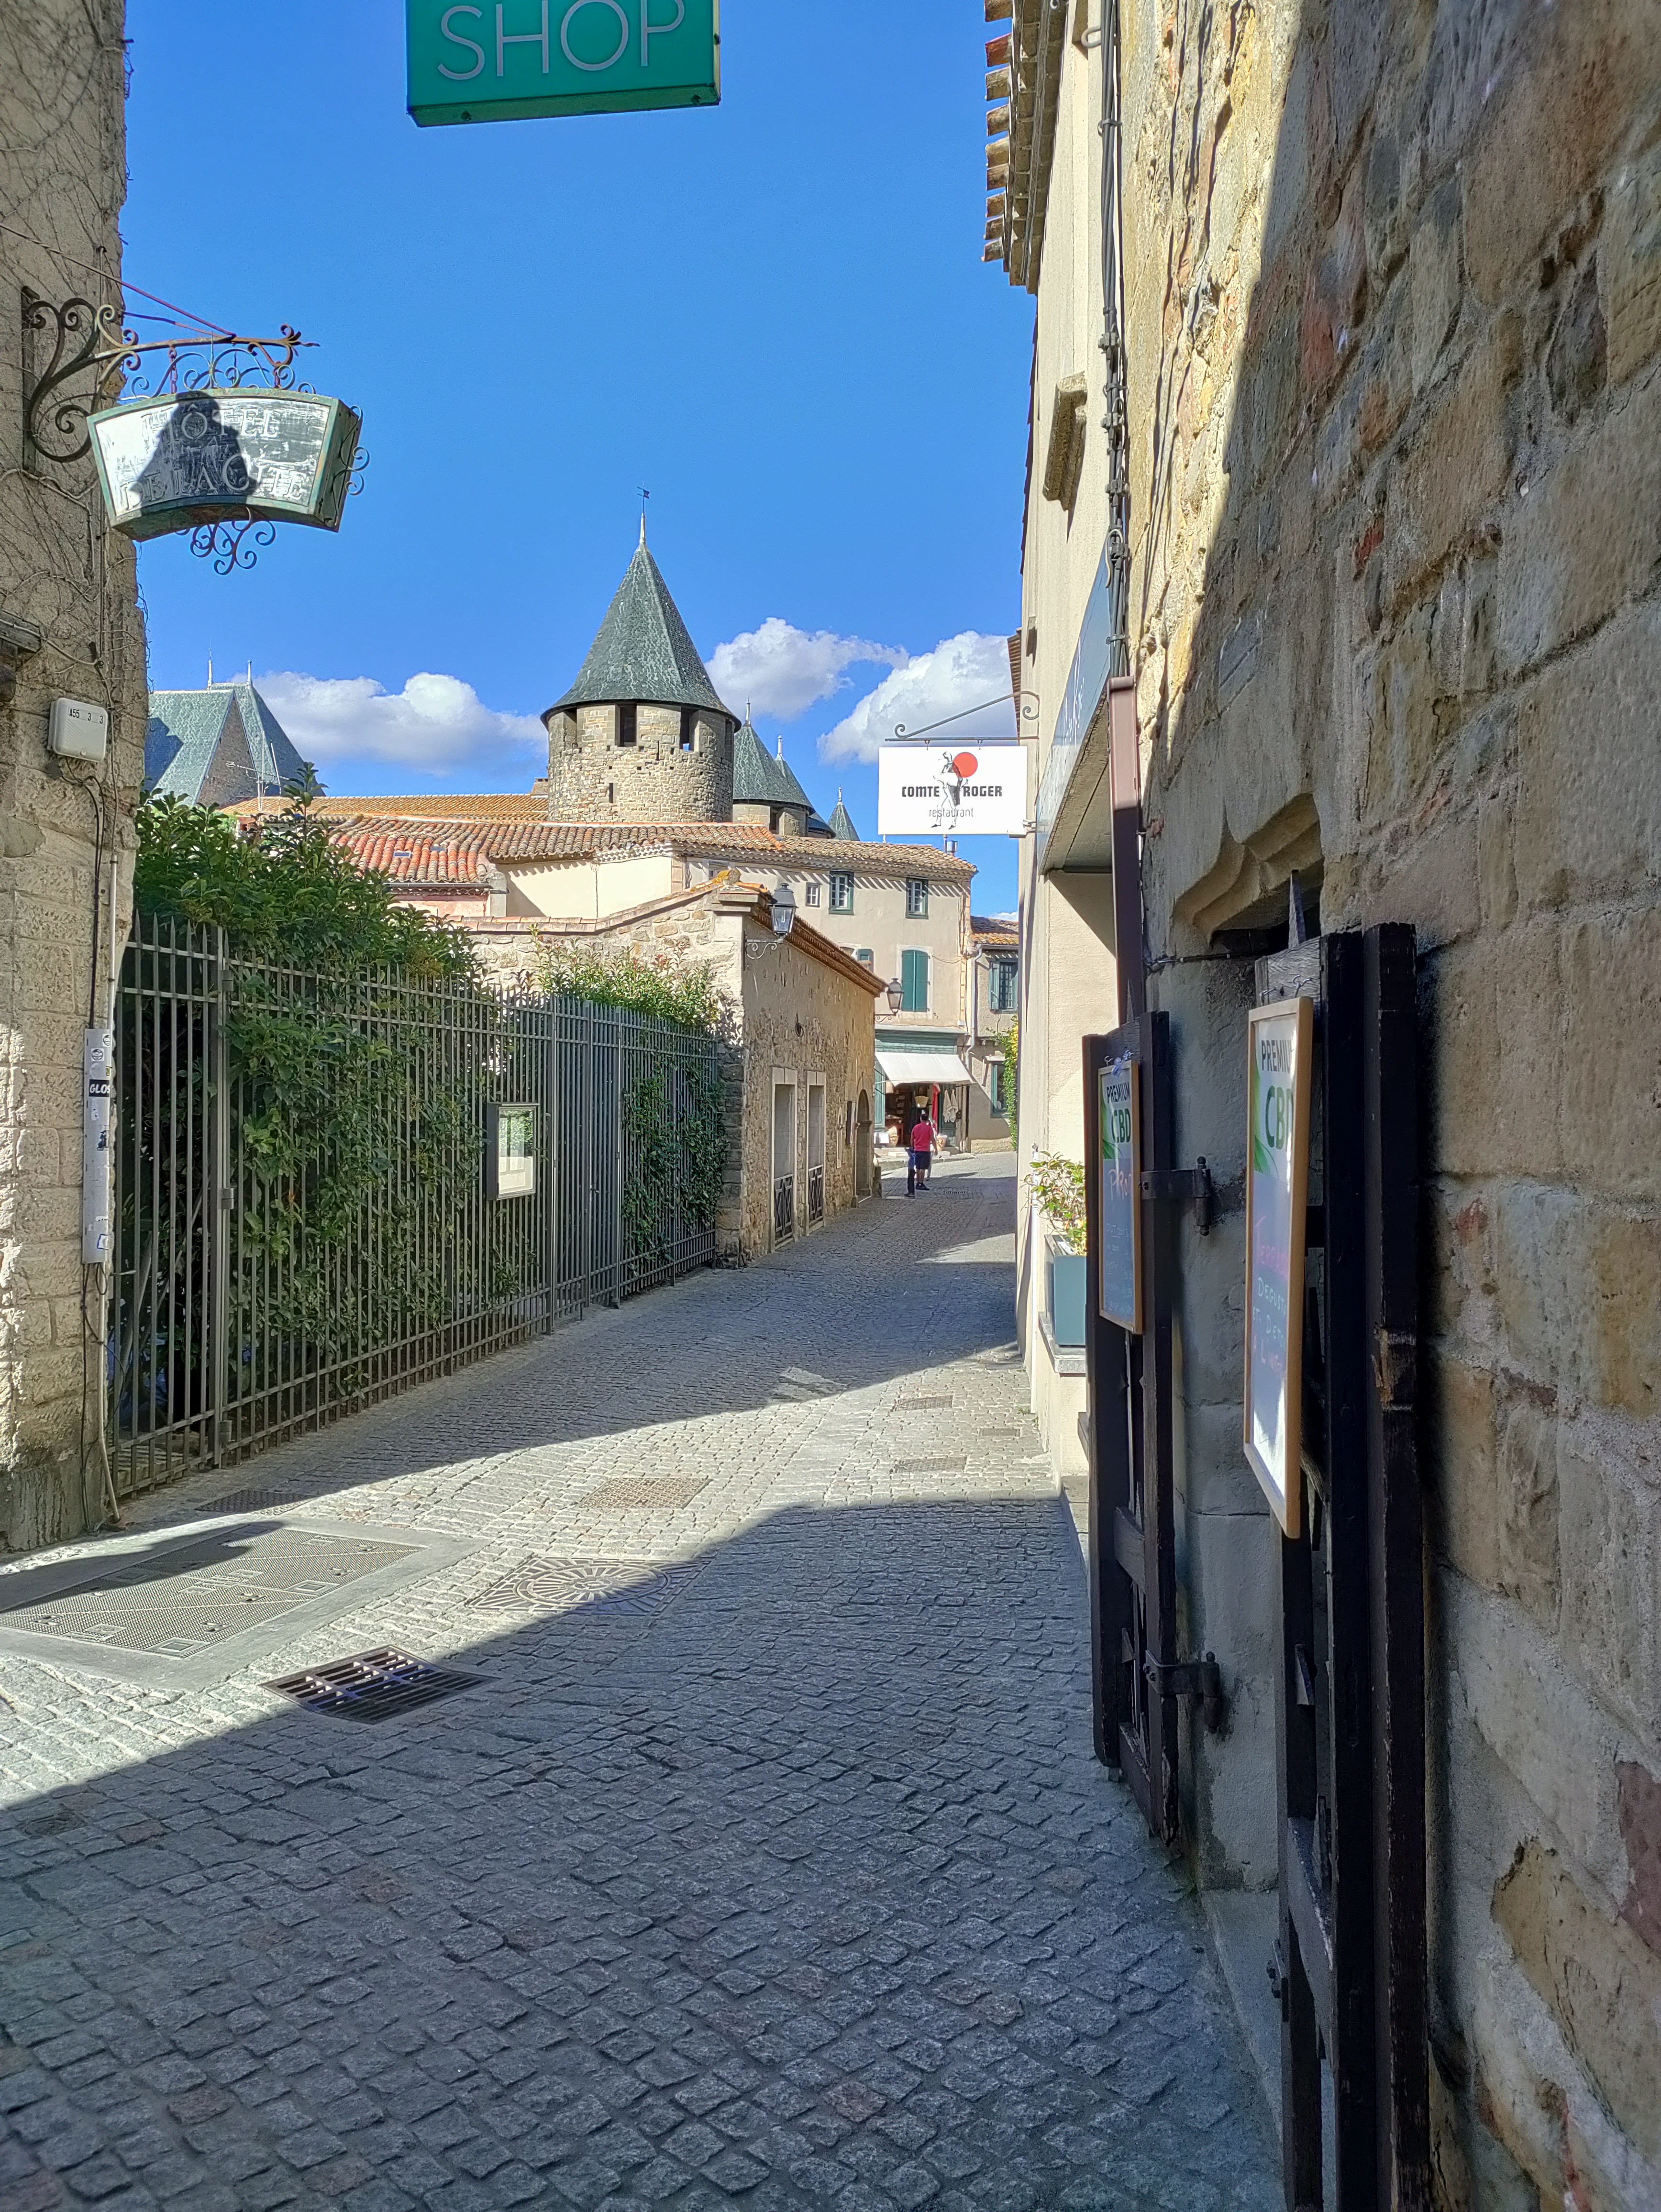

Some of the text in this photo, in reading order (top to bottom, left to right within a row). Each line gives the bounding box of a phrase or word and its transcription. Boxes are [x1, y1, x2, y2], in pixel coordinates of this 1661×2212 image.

[437, 0, 685, 80] SHOP
[141, 403, 279, 455] HÔTEL
[120, 471, 166, 510] DE
[171, 465, 218, 496] LA
[69, 708, 103, 724] A55 3 3
[901, 785, 1002, 797] COMTE ROGER
[929, 807, 974, 817] restaurant
[1261, 1040, 1295, 1074] PREMIU
[1106, 1082, 1131, 1104] PREMIUM
[1111, 1108, 1131, 1144] CBD
